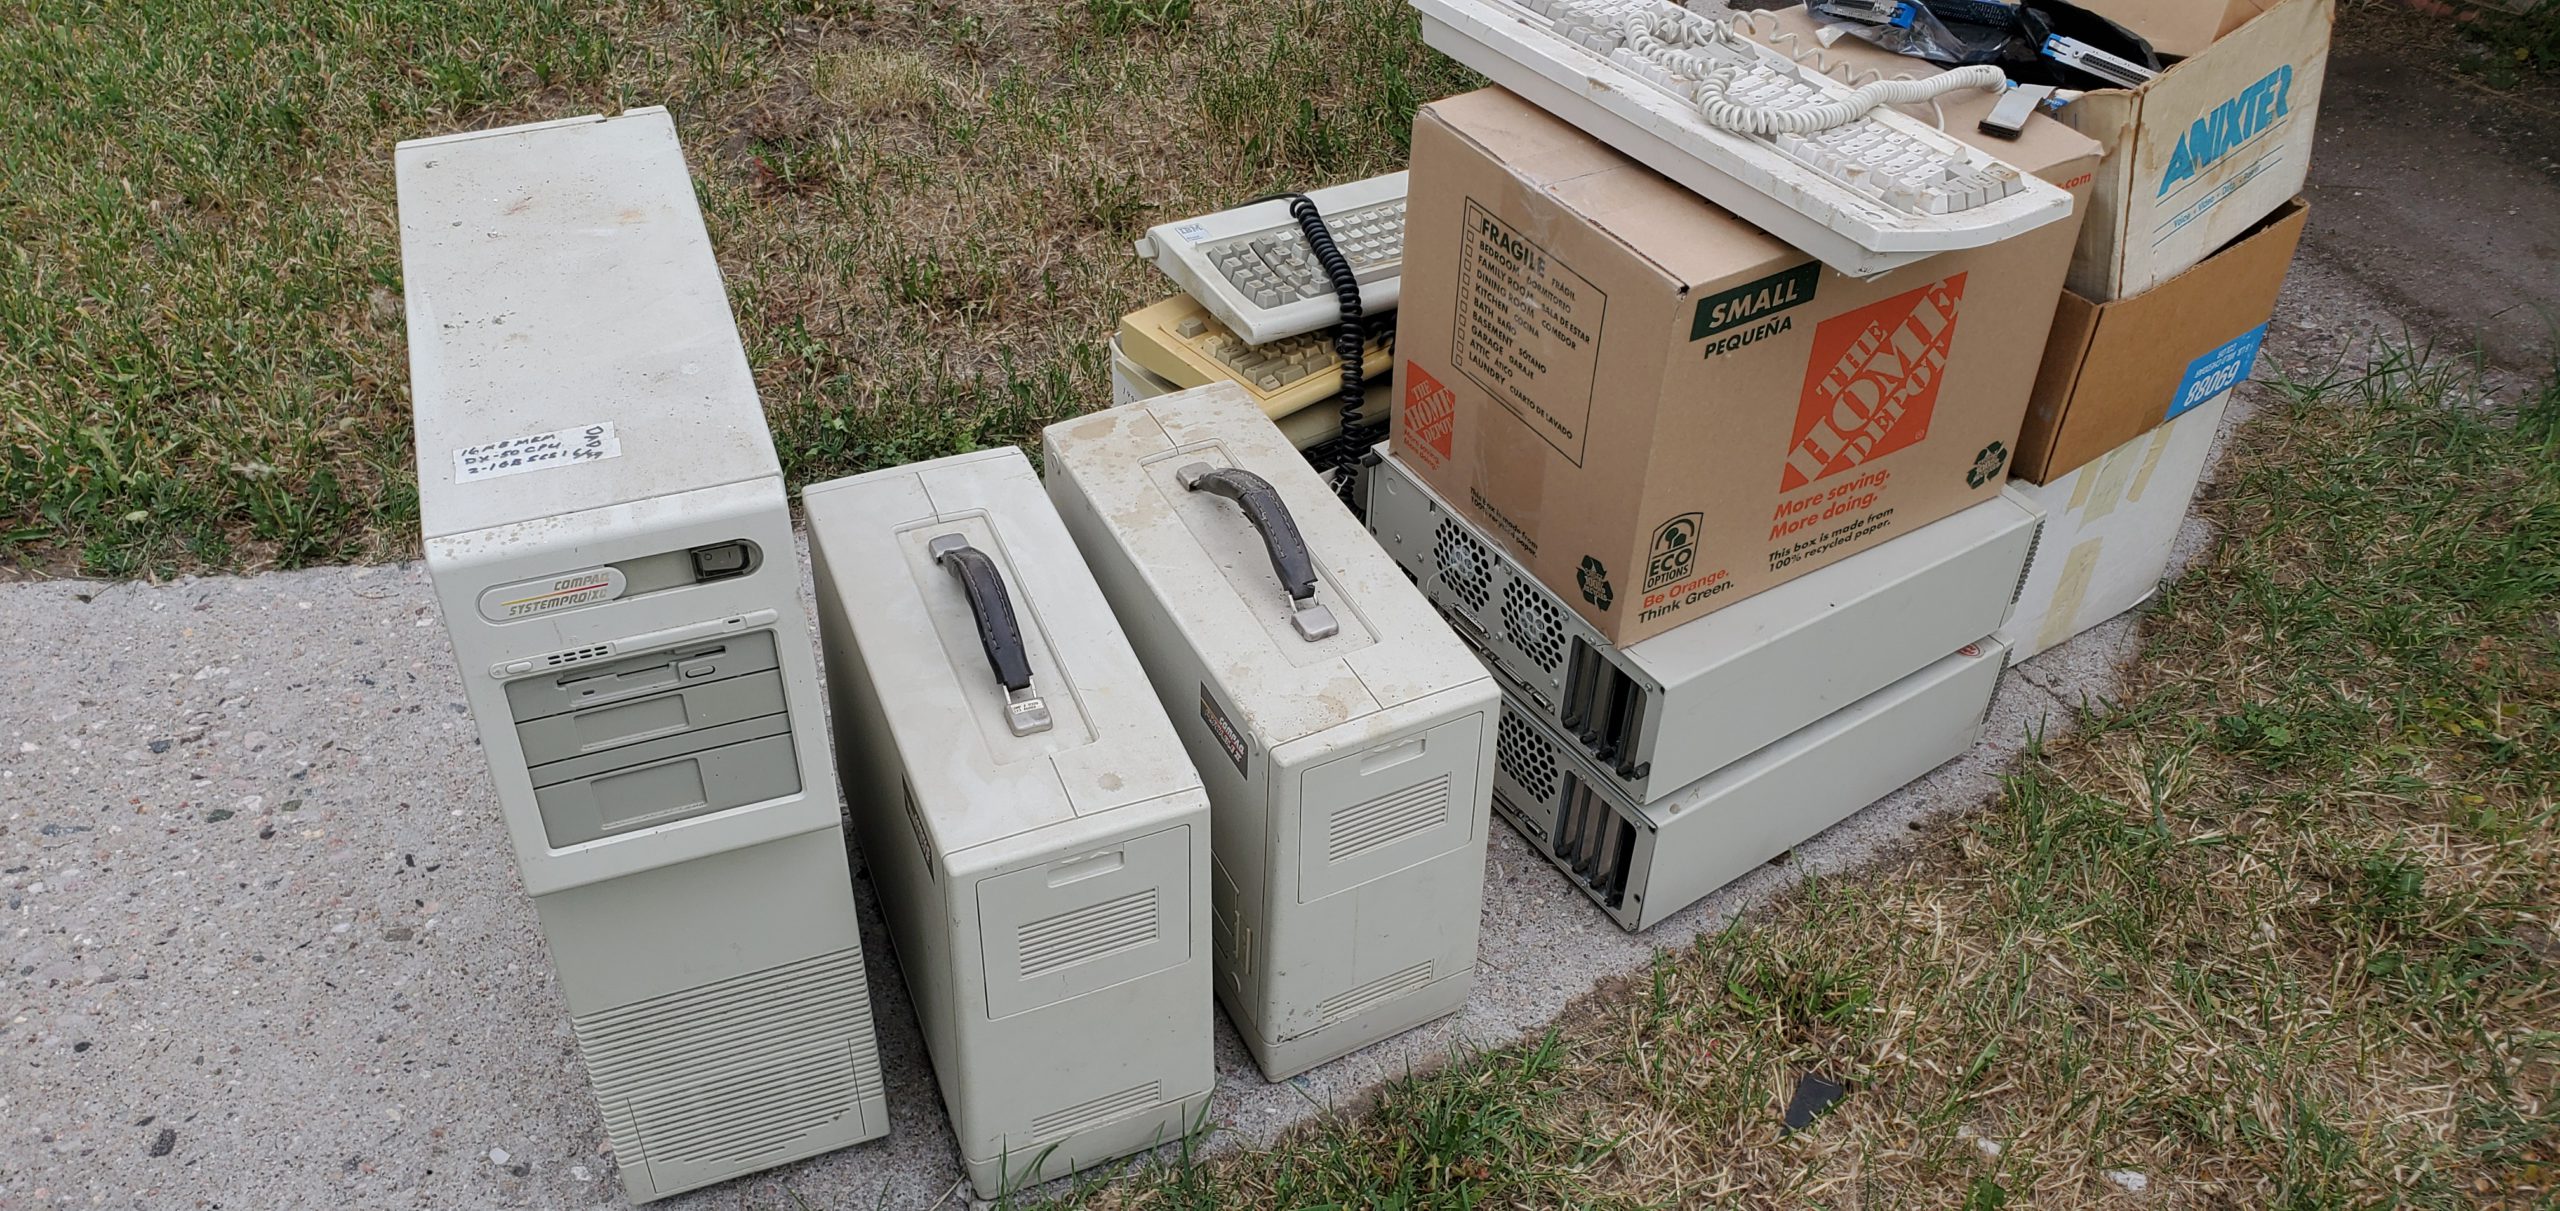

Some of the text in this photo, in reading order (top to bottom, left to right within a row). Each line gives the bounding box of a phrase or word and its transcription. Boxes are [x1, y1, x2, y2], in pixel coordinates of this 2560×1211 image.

[2156, 64, 2293, 199] ANIXTER
[1482, 217, 1546, 278] FRAGILE
[1478, 255, 1591, 345] FAMILY ROOM SALA DE ESTAR
[1479, 240, 1572, 314] BEDROOM DORMITORIO
[1473, 297, 1517, 337] BATH BAÑO
[1475, 284, 1540, 339] KITCHEN COCINA
[1476, 269, 1577, 351] DINING ROOM COMEDOR
[1708, 278, 1798, 329] SMALL
[1470, 339, 1491, 360] ATTIC
[1471, 325, 1535, 381] GARAGE GARAJE
[1472, 310, 1548, 374] BASEMENT SÓTANO
[1703, 315, 1792, 360] PEQUEÑA
[1815, 319, 1888, 399] THE
[1468, 351, 1574, 440] LAUNDRY CUARTO DE LAVADO
[1787, 280, 1961, 482] HOME
[1842, 340, 1947, 466] DEPOT
[1405, 387, 1455, 432] HOME
[513, 434, 555, 447] MEM
[524, 442, 562, 454] CPU
[1469, 486, 1482, 502] This
[1502, 516, 1521, 535] made
[1521, 531, 1539, 550] from
[1769, 492, 1879, 541] More doing.
[1774, 469, 1891, 520] More saving.
[1515, 537, 1538, 559] paper.
[1769, 507, 1894, 563] This box is made from
[1769, 519, 1892, 573] 100% recycled paper.
[554, 571, 610, 591] COMPAQ
[1647, 564, 1689, 588] OPTIONS
[1649, 547, 1692, 578] ECO
[1638, 580, 1735, 624] Think Green.
[1643, 568, 1729, 609] Be Orange.
[1219, 716, 1245, 756] COMPAQ
